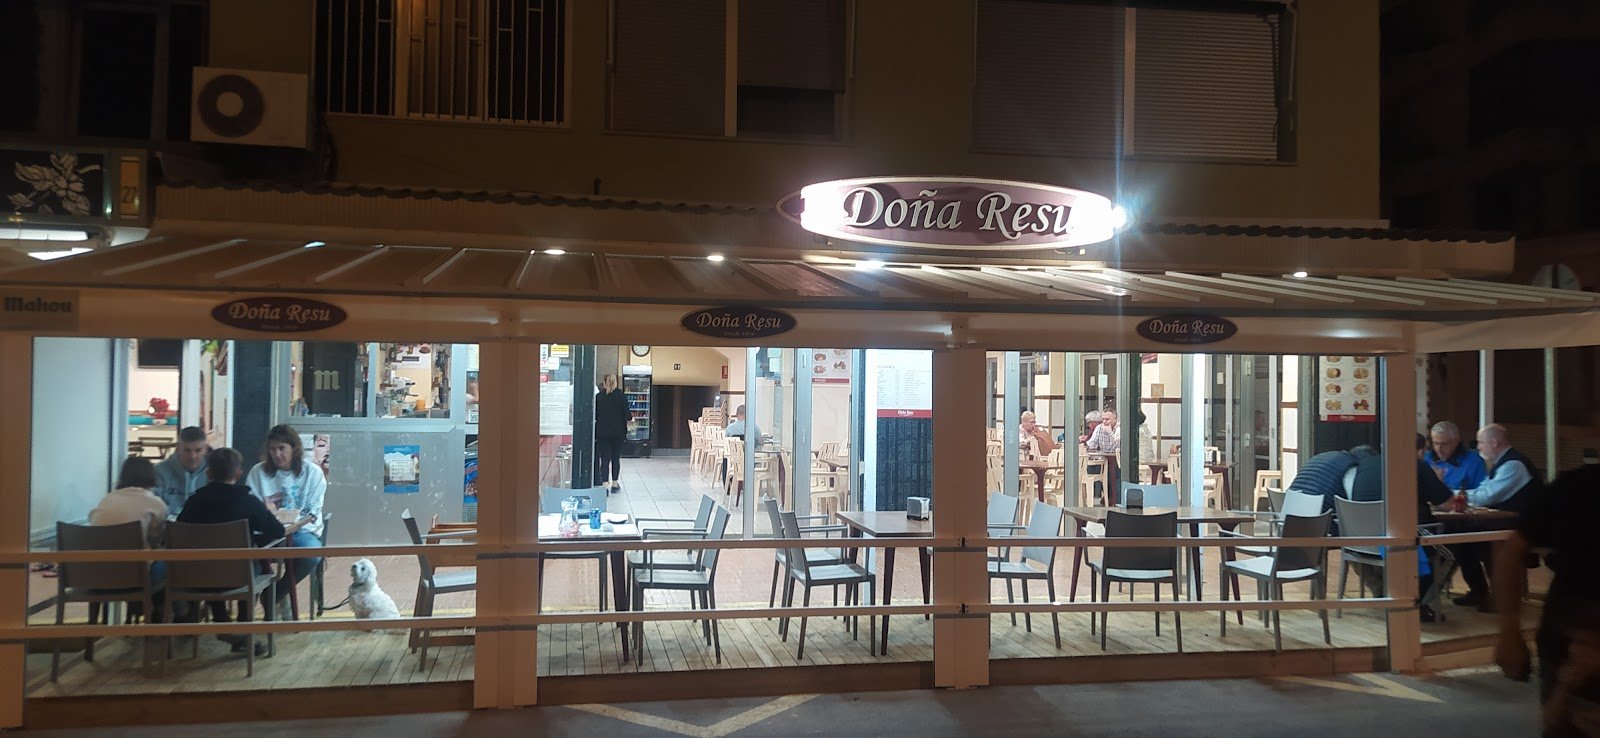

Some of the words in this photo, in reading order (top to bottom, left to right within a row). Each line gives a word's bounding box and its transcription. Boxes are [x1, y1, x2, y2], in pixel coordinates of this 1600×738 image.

[843, 187, 963, 230] Doña
[3, 296, 72, 313] Mahou
[228, 302, 281, 321] Doña
[286, 304, 332, 324] Resu
[696, 312, 740, 328] Doña
[745, 313, 782, 331] Resu
[1149, 319, 1188, 334] Doña
[1192, 319, 1225, 337] Resu
